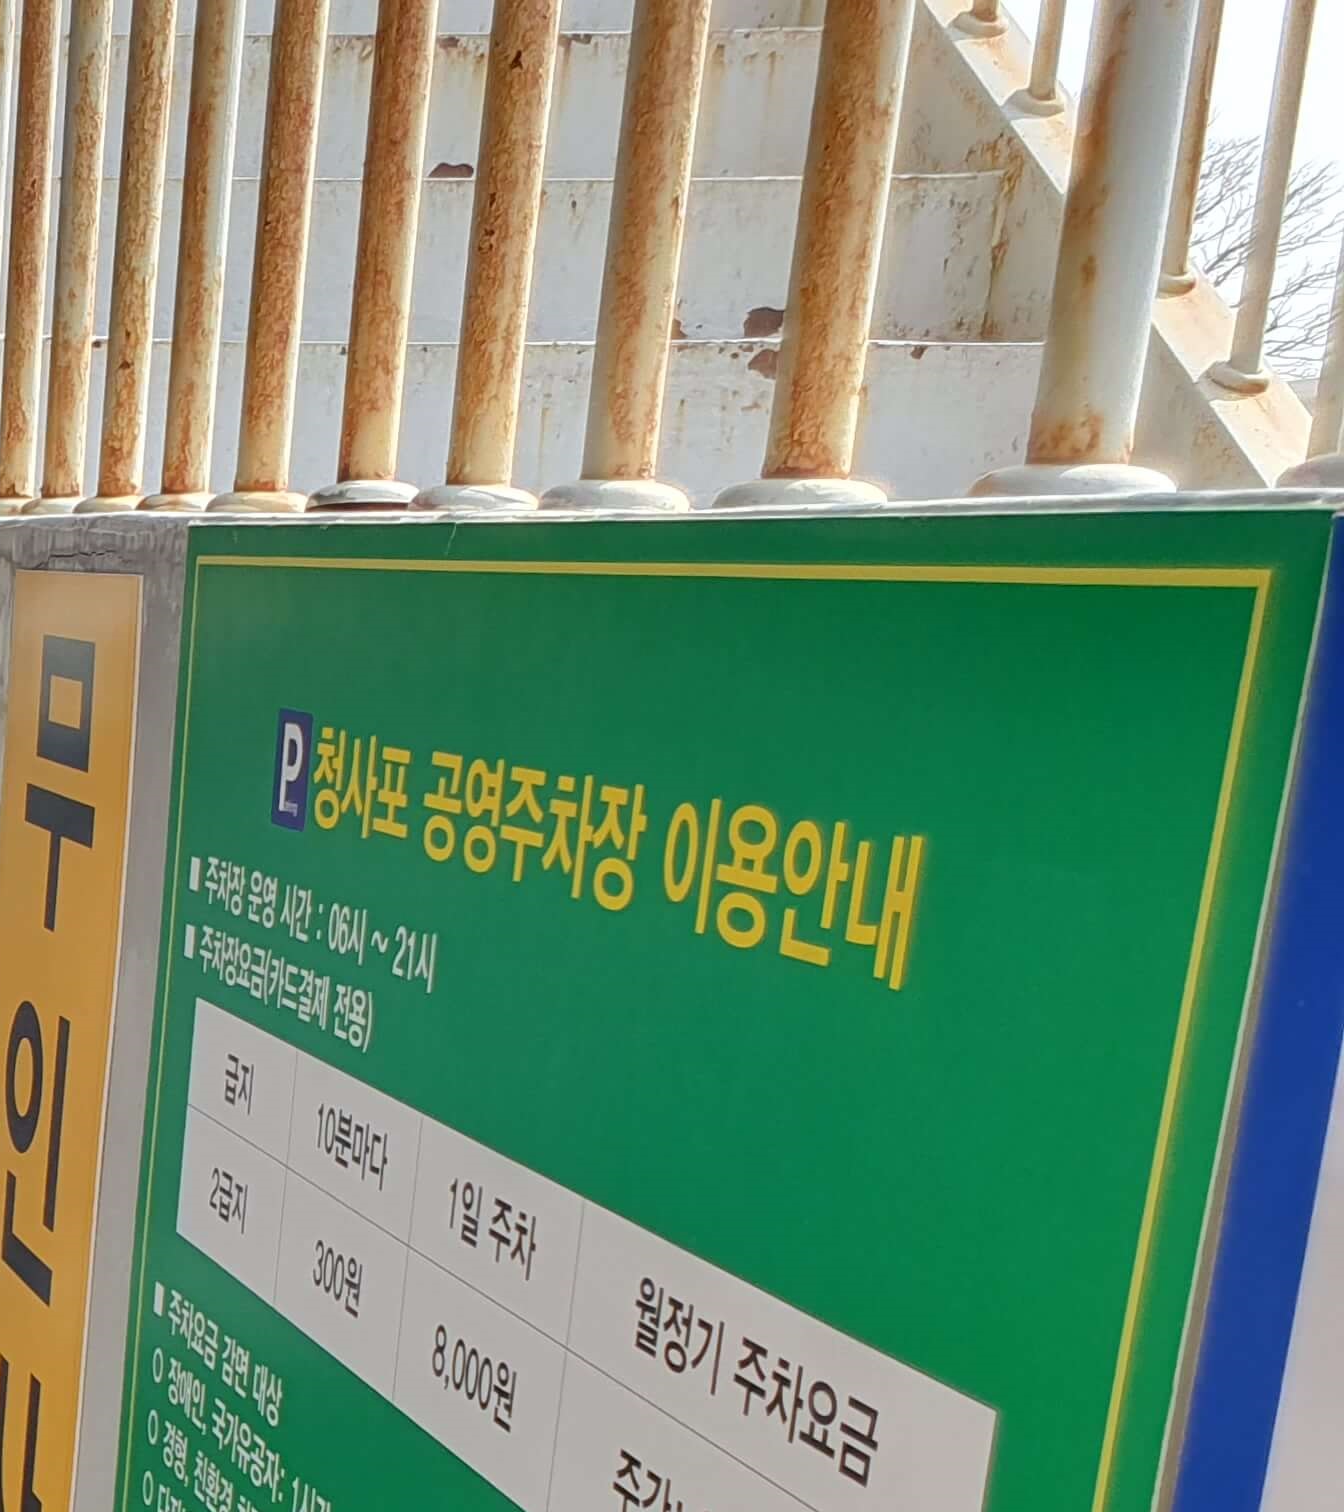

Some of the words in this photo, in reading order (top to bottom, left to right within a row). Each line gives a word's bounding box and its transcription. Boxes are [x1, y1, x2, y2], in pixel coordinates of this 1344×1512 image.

[204, 857, 246, 916] 주차장
[247, 871, 278, 928] 운영
[280, 885, 313, 942] 시간
[328, 903, 367, 965] 06시
[392, 926, 437, 993] 21시
[313, 727, 411, 839] 청사포
[423, 750, 647, 911] 공영주차장
[663, 798, 924, 990] 이용안내
[334, 984, 374, 1053] 전용)
[209, 1167, 248, 1234] 2급지
[312, 1240, 363, 1319] 300원
[432, 1324, 517, 1433] 8,000원
[224, 1054, 254, 1115] 급지
[317, 1103, 388, 1191] 10분마다
[449, 1178, 483, 1249] 1일
[488, 1198, 537, 1281] 주차
[633, 1276, 726, 1396] 월정기
[732, 1336, 880, 1487] 주차요금
[168, 1289, 218, 1371] 주차요금
[222, 1335, 250, 1398] 감면
[252, 1364, 282, 1427] 대상
[162, 1420, 189, 1488] 경형,
[168, 1357, 207, 1436] 장애인,
[212, 1398, 286, 1503] 국가유공자:
